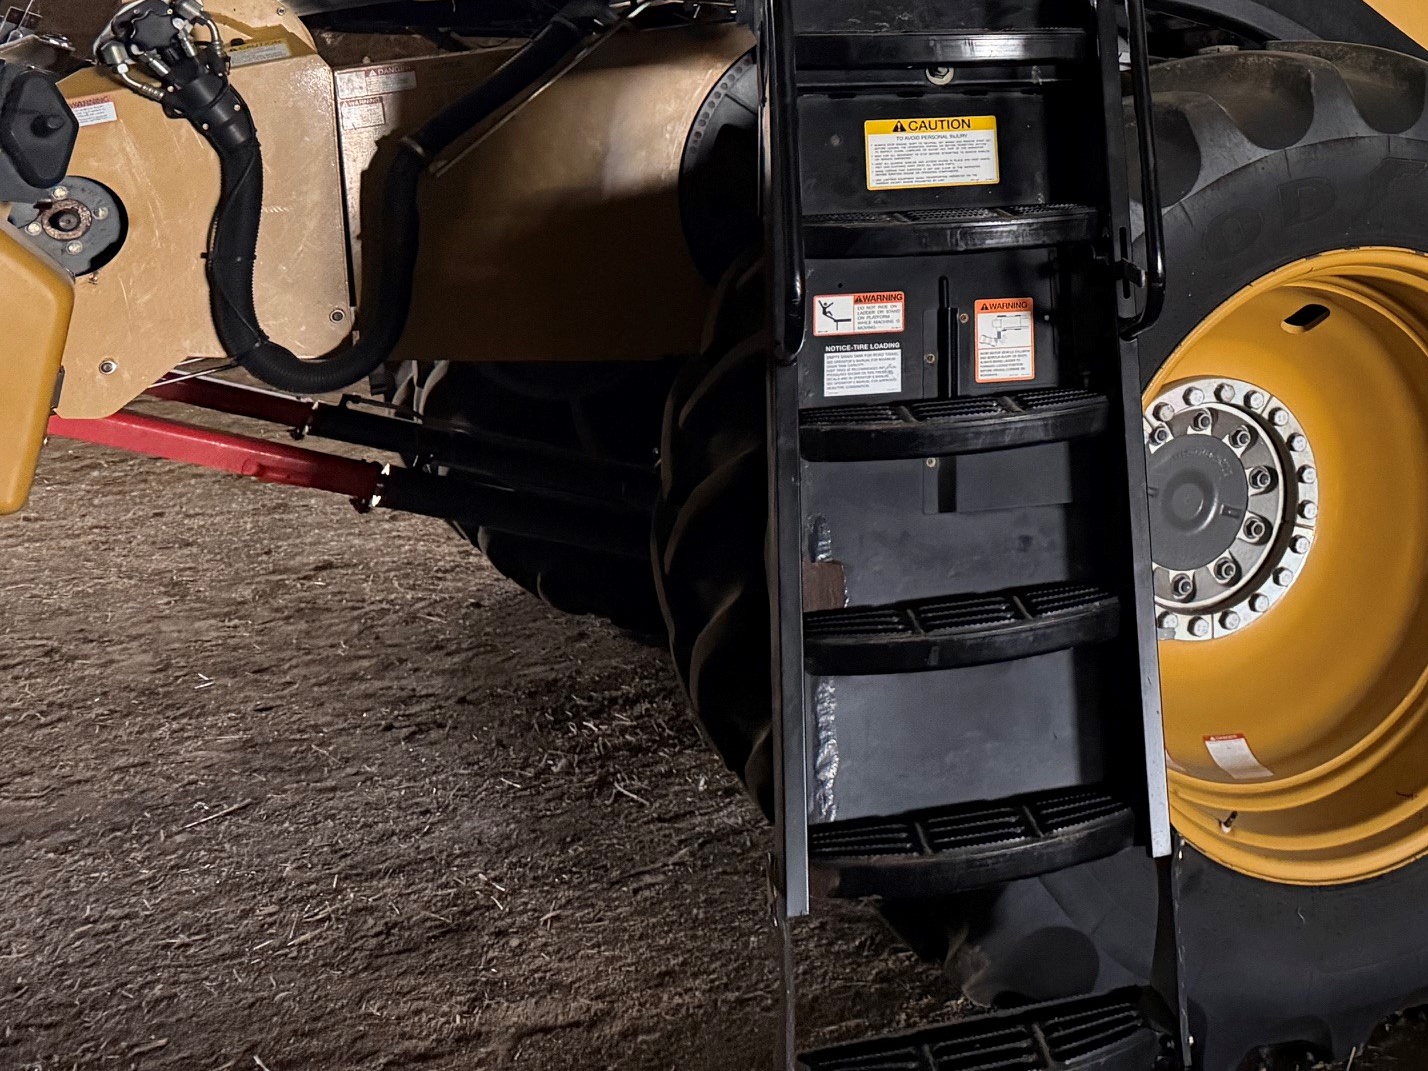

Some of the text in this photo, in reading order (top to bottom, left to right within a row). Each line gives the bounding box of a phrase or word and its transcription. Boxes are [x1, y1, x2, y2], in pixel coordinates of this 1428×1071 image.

[908, 119, 971, 132] CAUTION
[862, 293, 903, 302] WARNING
[989, 302, 1027, 310] WARNING
[825, 342, 900, 352] NOTICE-TIRE LOADING
